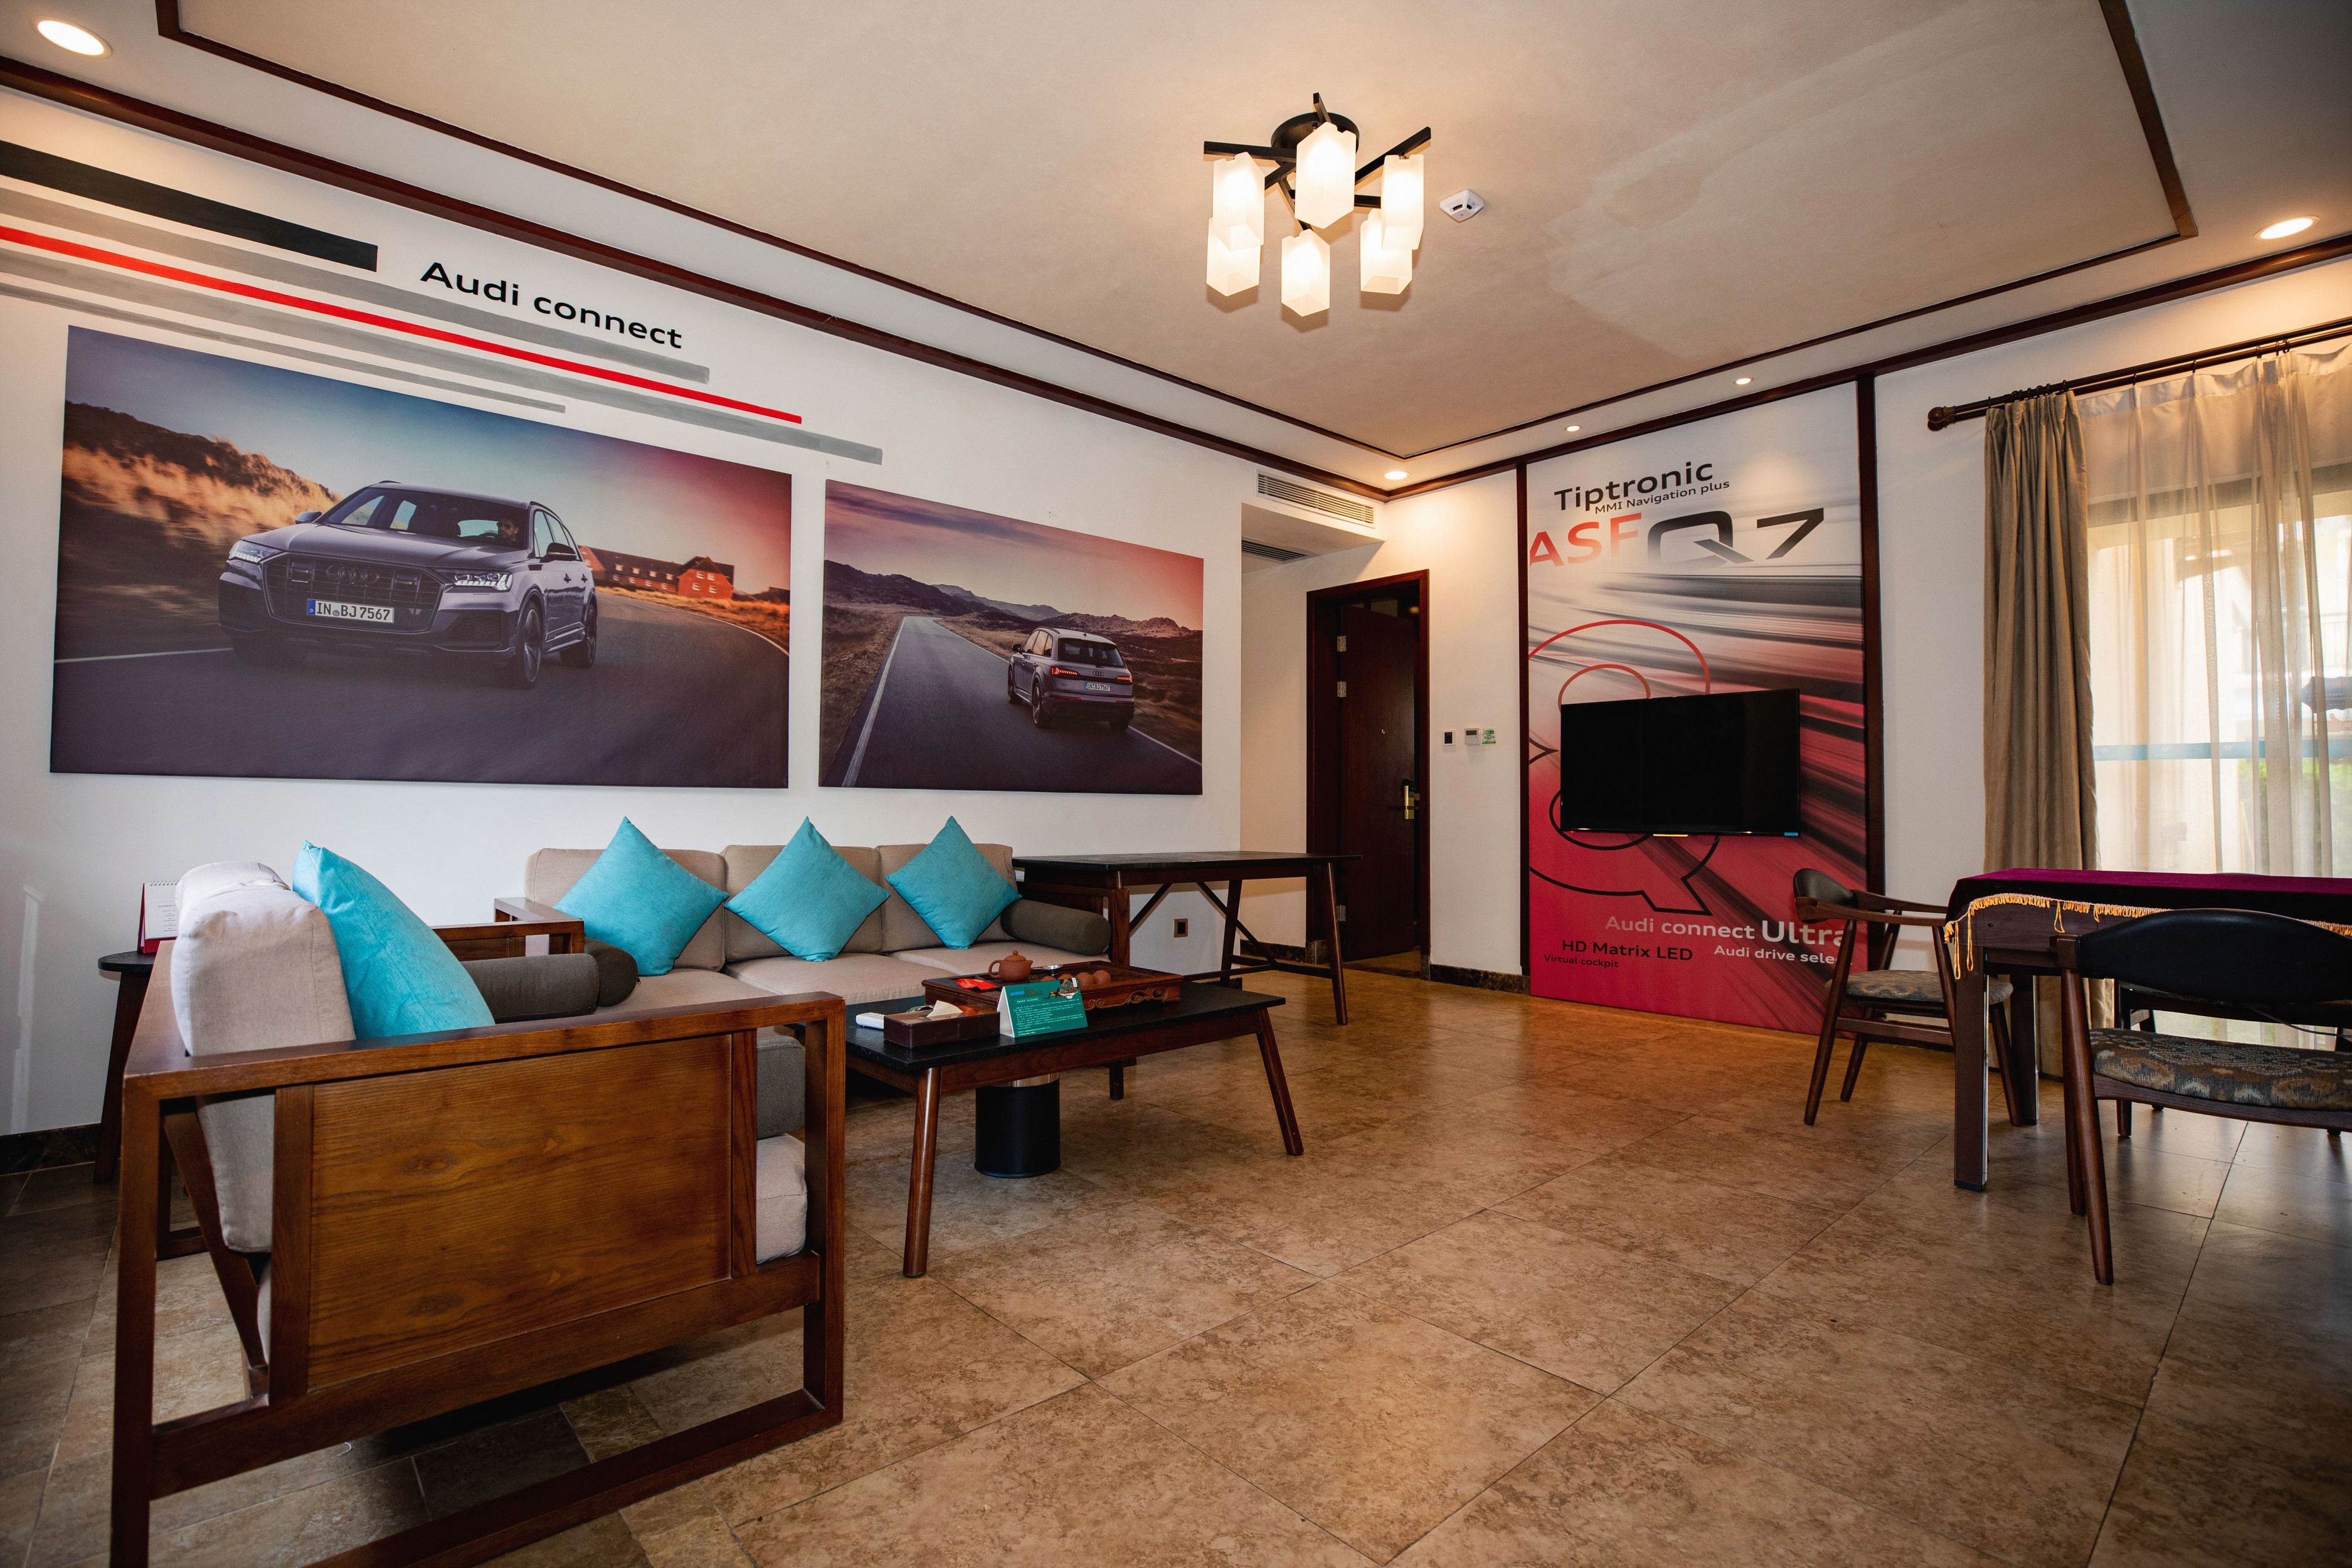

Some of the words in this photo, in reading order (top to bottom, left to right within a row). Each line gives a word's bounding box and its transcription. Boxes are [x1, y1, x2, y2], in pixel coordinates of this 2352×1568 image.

[420, 262, 519, 306] Audi
[533, 296, 682, 349] connect
[1554, 461, 1714, 511] Tiptronic
[1595, 501, 1623, 514] MMI
[1626, 489, 1697, 508] Navigation
[1700, 482, 1730, 495] plus
[1529, 512, 1642, 568] ASF
[317, 603, 331, 615] IN
[341, 605, 356, 617] BJ
[360, 607, 390, 620] 7567
[1605, 916, 1655, 933] Audi
[1661, 923, 1755, 940] connect
[1544, 954, 1579, 965] Virtual
[1581, 958, 1619, 969] cockpit
[1562, 940, 1587, 953] HD
[1593, 943, 1651, 958] Matrix
[1657, 946, 1693, 961] LED
[1714, 945, 1749, 958] Audi
[1754, 949, 1796, 961] drive
[1800, 953, 1852, 966] sele
